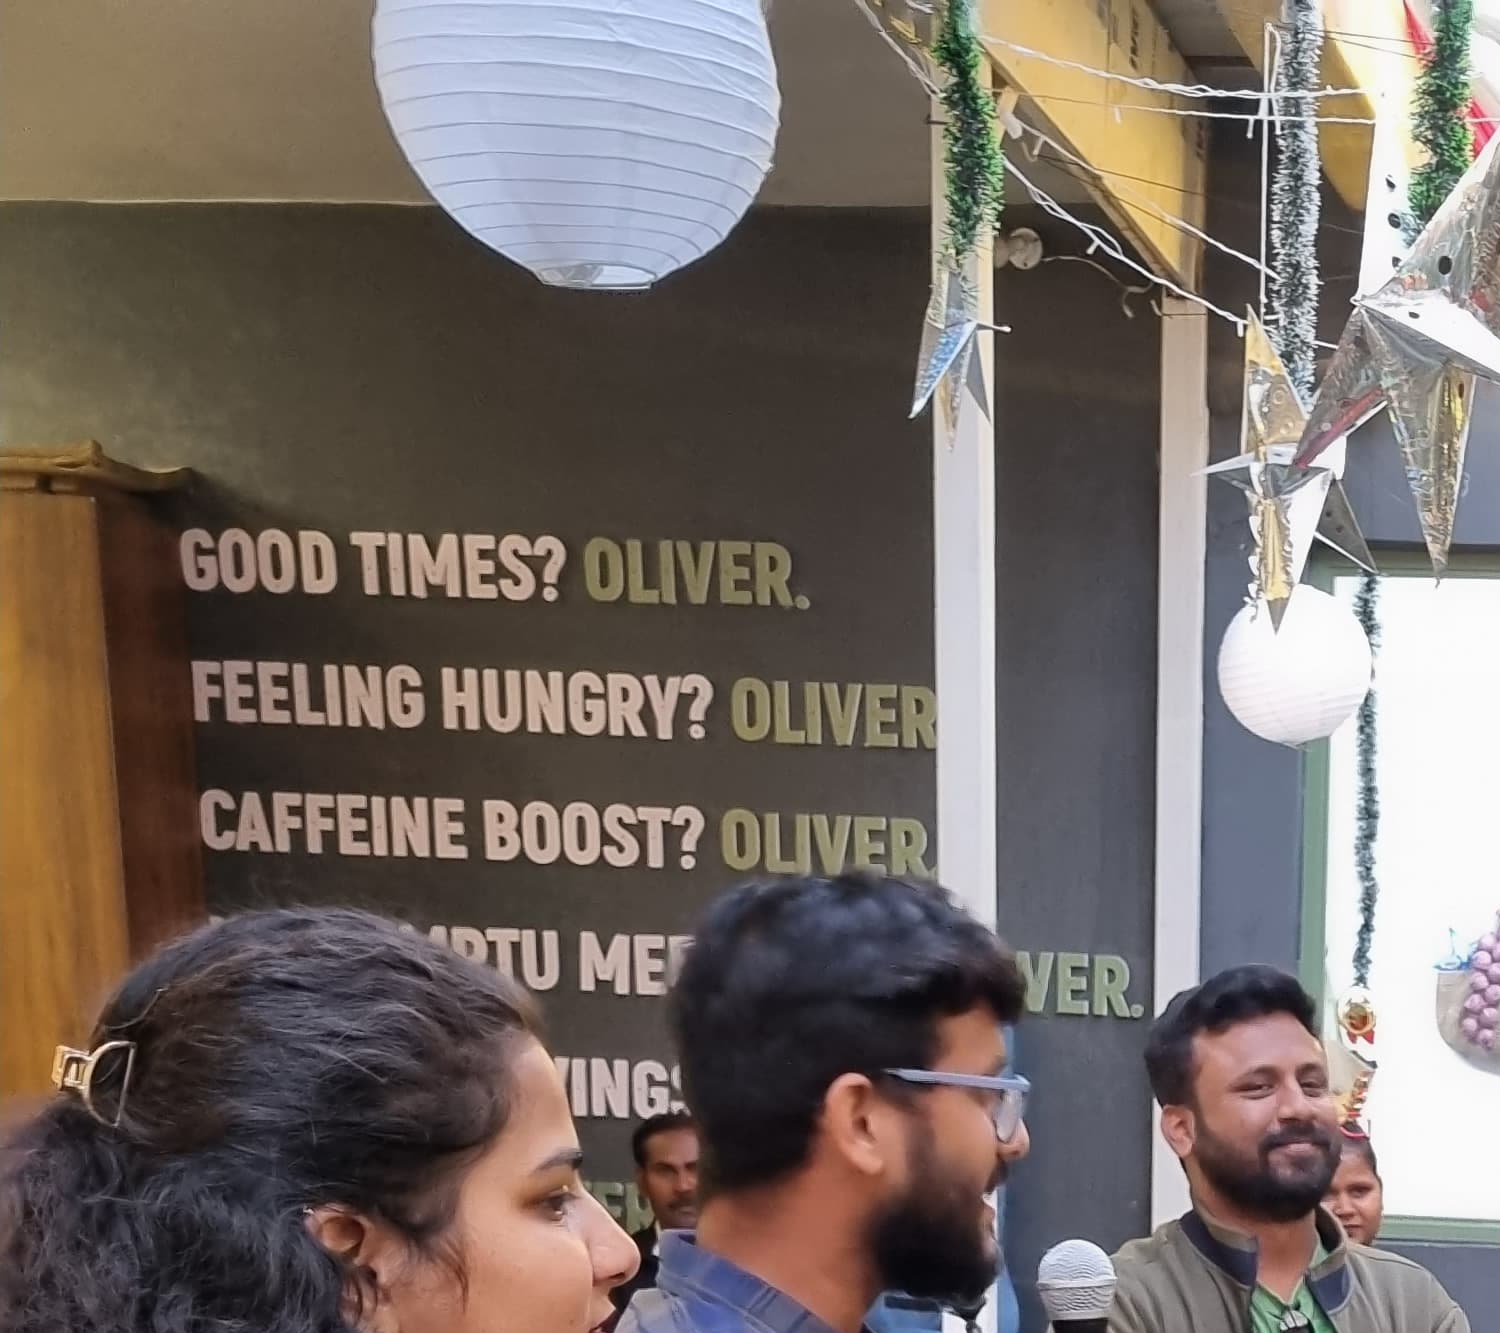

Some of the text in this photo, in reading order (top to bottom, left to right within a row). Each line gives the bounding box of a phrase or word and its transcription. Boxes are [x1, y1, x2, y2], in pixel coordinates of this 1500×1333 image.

[180, 527, 811, 610] GOOD TIMES? OLIVER.
[190, 659, 426, 731] FEELING
[441, 666, 714, 741] HUNGRY?
[200, 788, 469, 861] CAFFEINE
[482, 800, 705, 872] BOOST?
